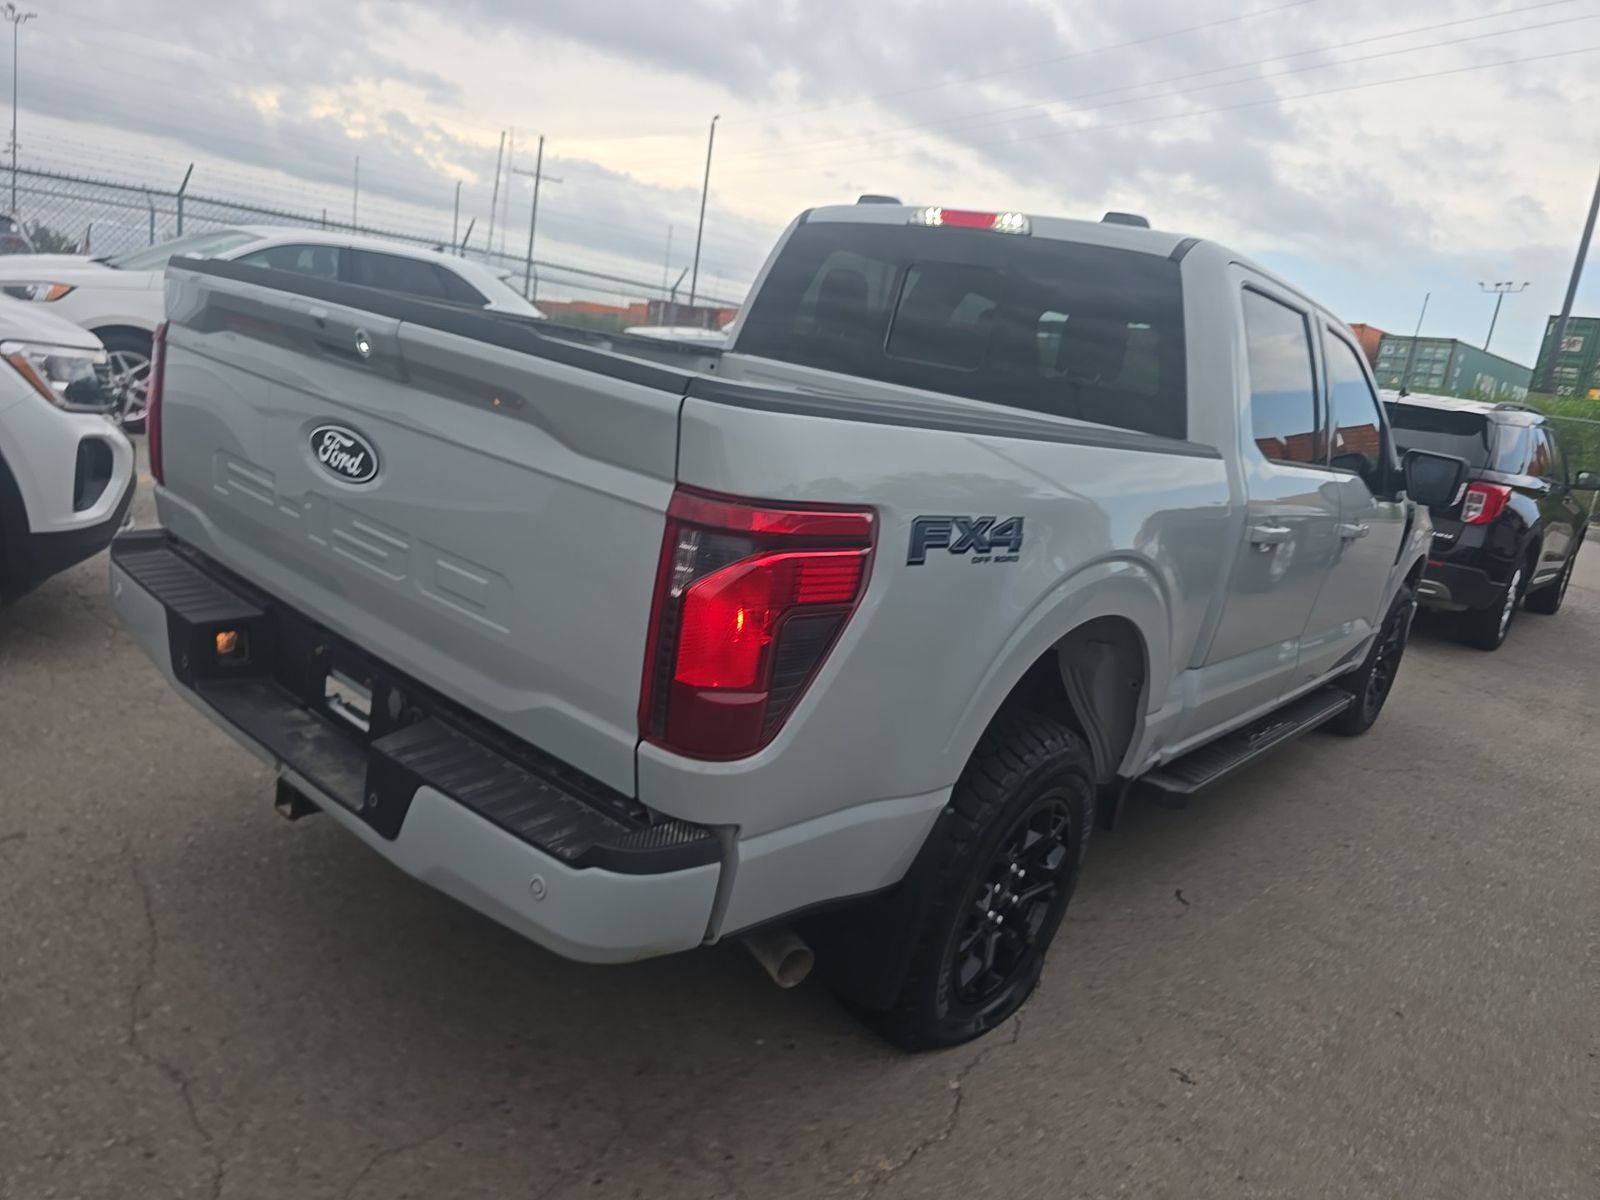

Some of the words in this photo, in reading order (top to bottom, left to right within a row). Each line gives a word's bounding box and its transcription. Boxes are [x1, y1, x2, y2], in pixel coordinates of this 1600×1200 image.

[317, 429, 364, 477] Ford
[212, 447, 515, 635] F-150
[906, 515, 1025, 567] FX4
